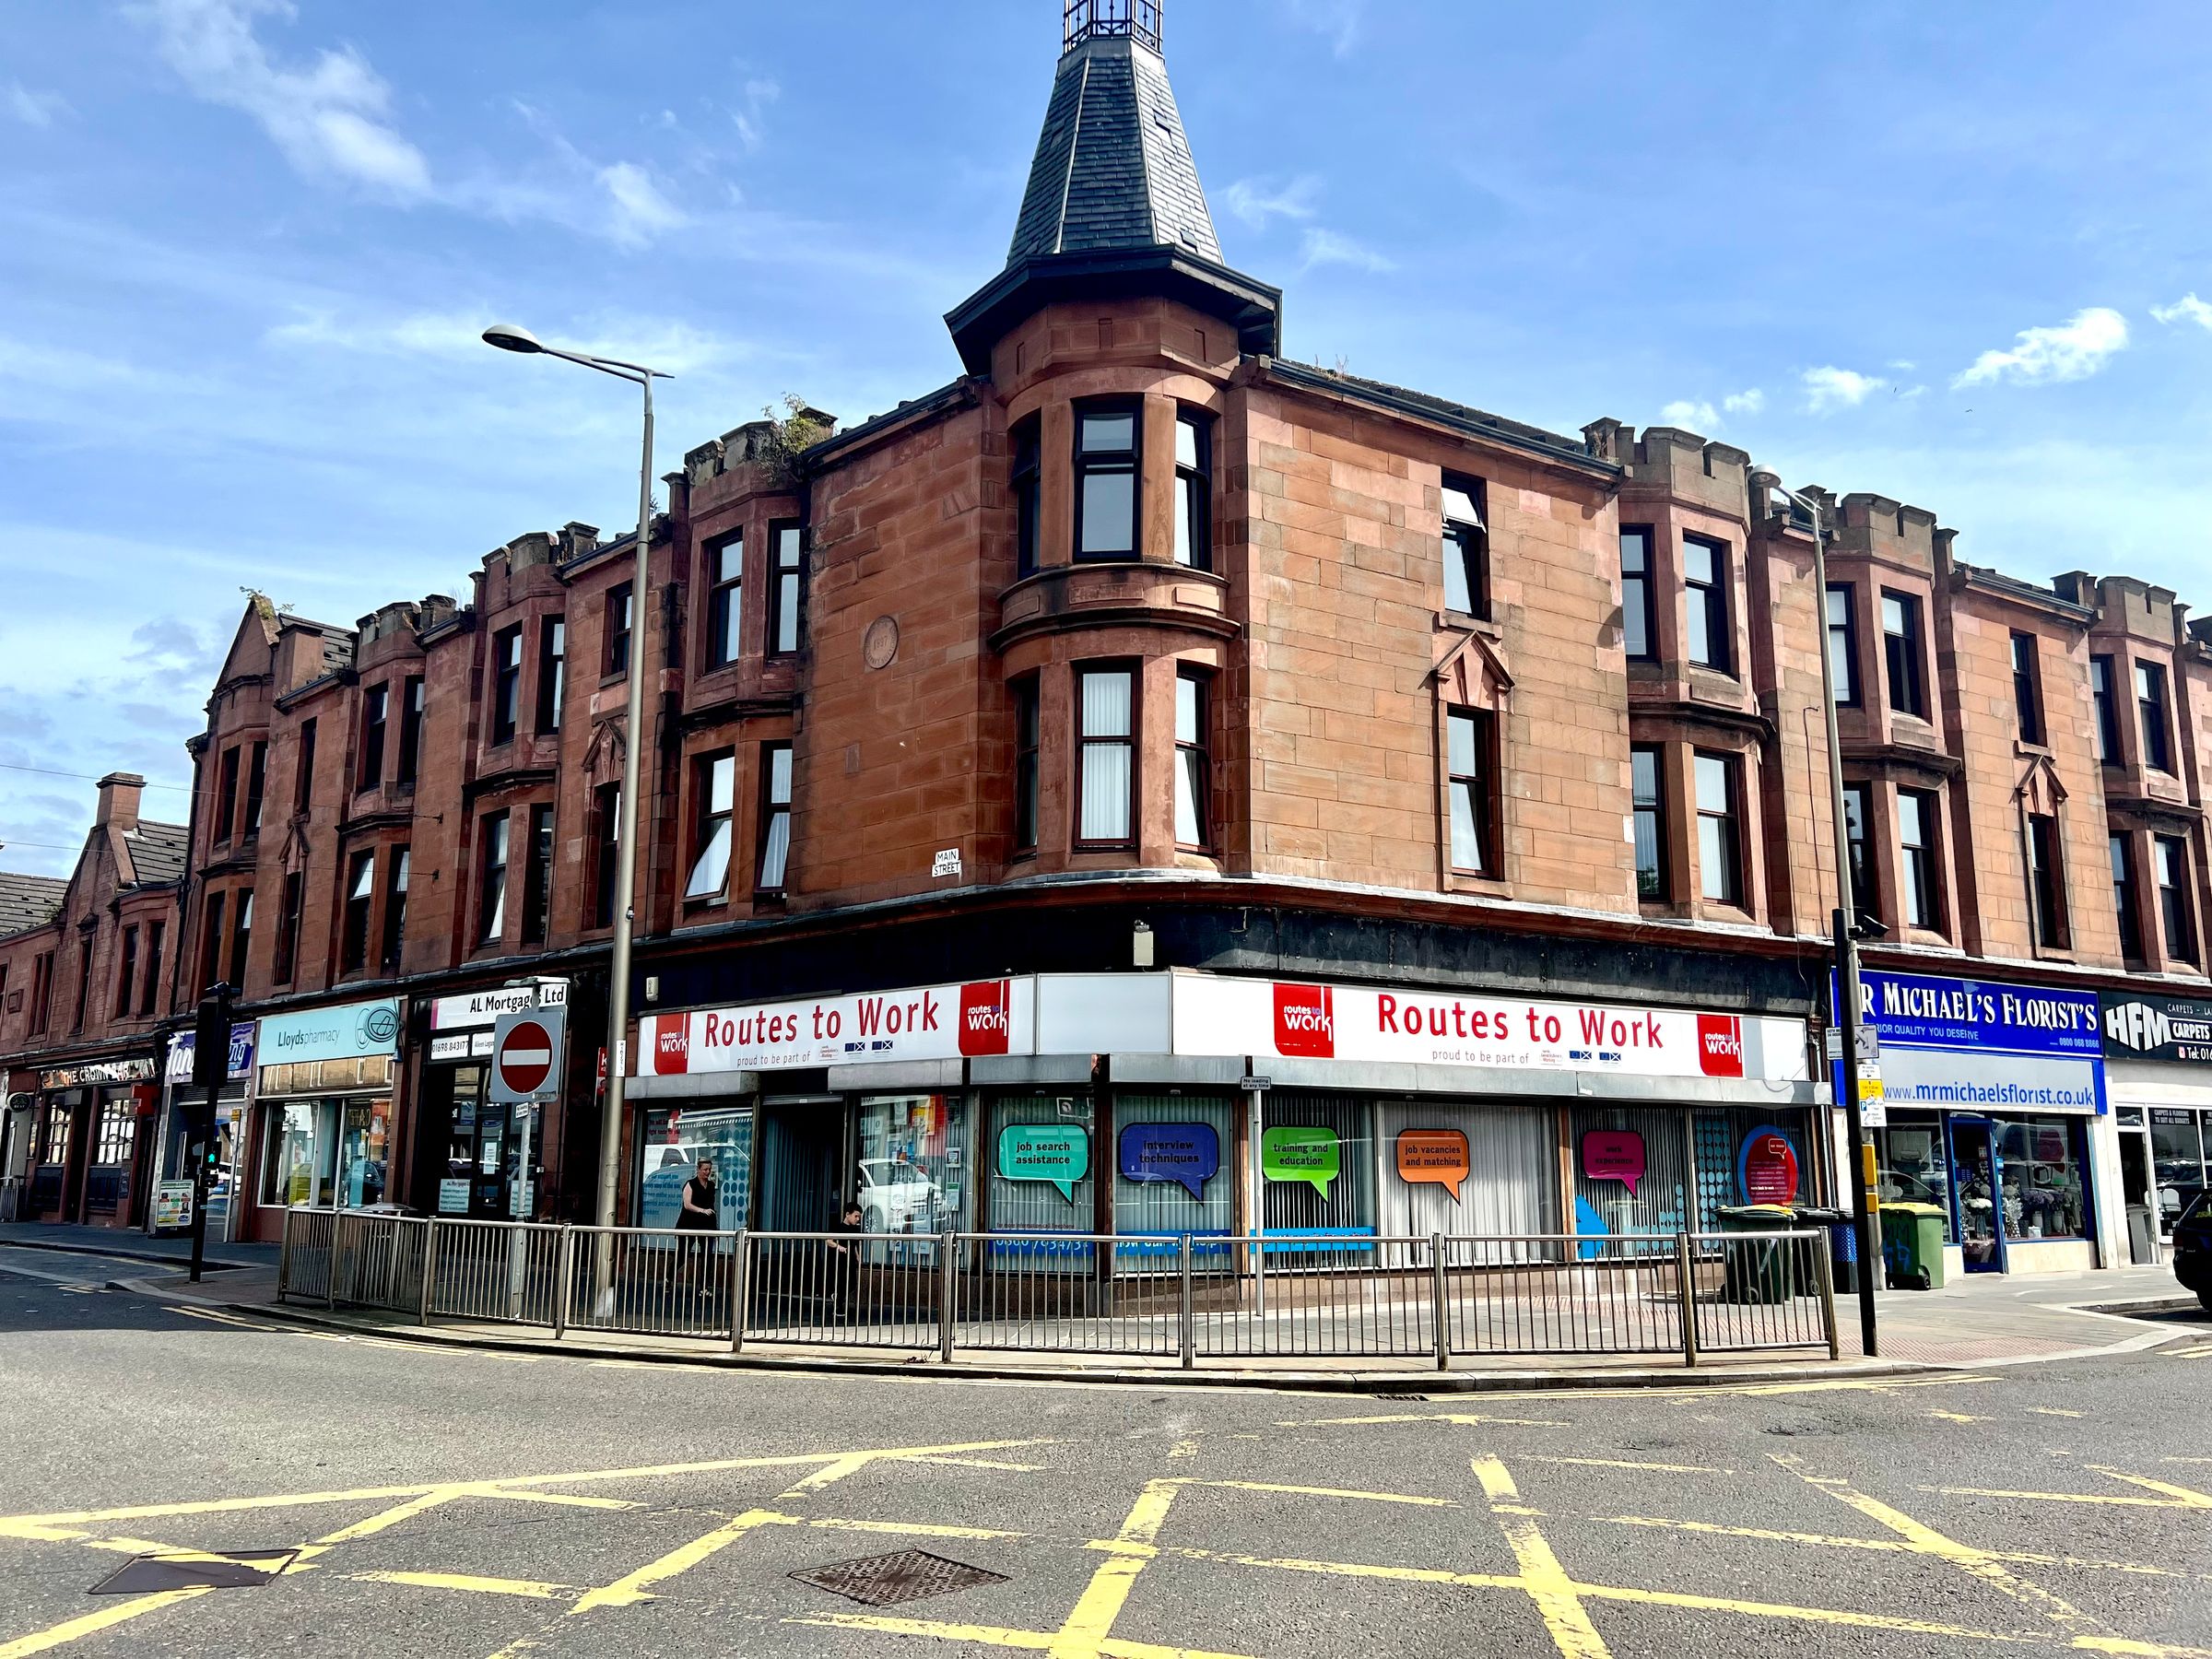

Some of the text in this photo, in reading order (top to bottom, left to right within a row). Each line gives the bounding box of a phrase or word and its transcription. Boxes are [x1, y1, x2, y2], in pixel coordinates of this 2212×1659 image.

[937, 851, 957, 863] MAIN
[934, 863, 959, 876] STREET
[470, 998, 482, 1013] AL
[545, 986, 565, 1004] Ltd
[1883, 982, 1996, 1024] MICHAEL'S
[2001, 993, 2098, 1031] FLORIST'S
[968, 1005, 992, 1015] routes
[1284, 1005, 1321, 1015] routes to
[2167, 1003, 2194, 1015] CARPETS
[705, 990, 939, 1047] Routes to Work
[968, 1011, 1008, 1037] work
[1378, 994, 1664, 1049] Routes to Work
[2105, 1002, 2172, 1051] HFM
[1284, 1014, 1332, 1041] work
[1894, 1024, 1926, 1036] QUALITY
[1929, 1027, 1945, 1037] YOU
[1946, 1028, 1979, 1041] DESERVE
[2172, 1021, 2210, 1041] CARPETS
[277, 1027, 340, 1050] Lloydspharmacy
[1705, 1032, 1726, 1041] routes
[661, 1037, 688, 1059] work
[1705, 1040, 1742, 1063] work
[737, 1051, 810, 1067] proud to be part of
[1432, 1049, 1529, 1065] proud to be part of
[63, 1071, 78, 1085] THE
[79, 1067, 109, 1082] CROWN
[1017, 1141, 1070, 1153] job search
[1143, 1140, 1194, 1150] interview
[1274, 1143, 1328, 1154] training and
[1406, 1145, 1461, 1155] job vacancies
[1016, 1154, 1070, 1164] assistance
[1139, 1154, 1199, 1164] techniques
[1279, 1156, 1324, 1166] education
[1406, 1157, 1462, 1167] and matching
